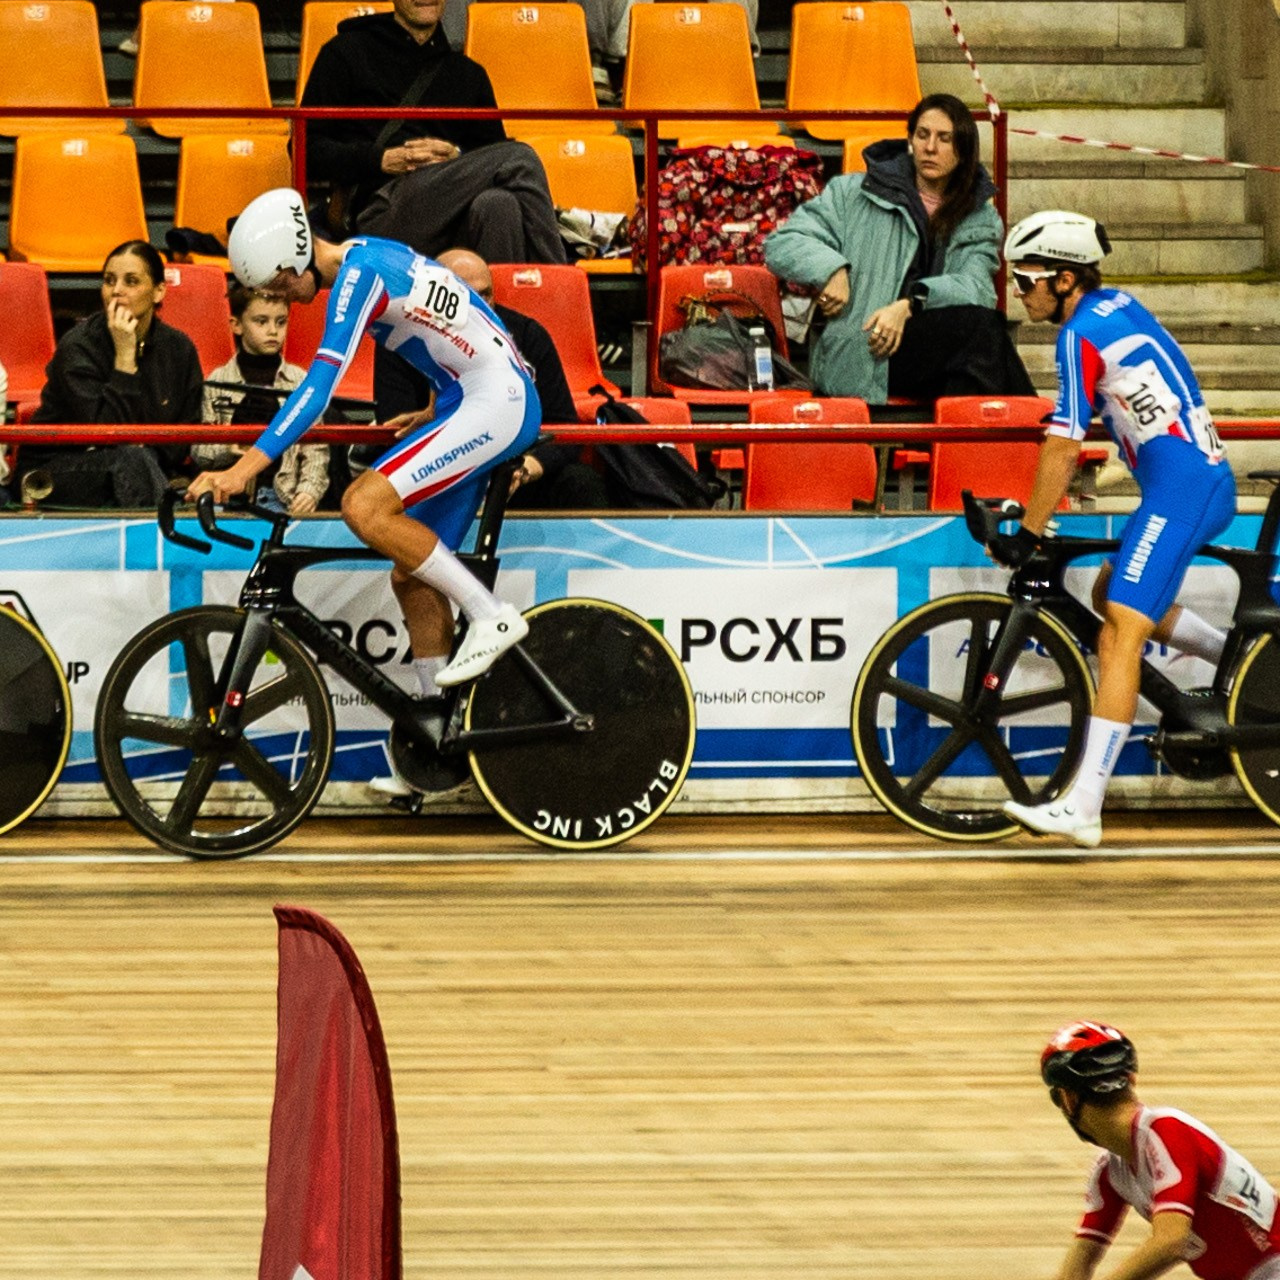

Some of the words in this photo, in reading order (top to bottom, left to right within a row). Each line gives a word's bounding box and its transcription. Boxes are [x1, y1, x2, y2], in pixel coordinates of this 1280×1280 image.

[517, 9, 533, 22] 38
[289, 204, 308, 257] KASK
[333, 265, 361, 323] RUSSIA
[424, 280, 459, 320] 108
[1124, 382, 1166, 426] 105
[411, 430, 494, 484] LOKOSPHINX
[1122, 513, 1168, 584] LOKOSPHINX
[681, 617, 847, 662] РСХБ
[694, 689, 747, 704] ЛЬНЫЙ
[751, 691, 826, 704] СПОНСОР
[595, 759, 679, 838] BLACK
[533, 809, 583, 840] INC
